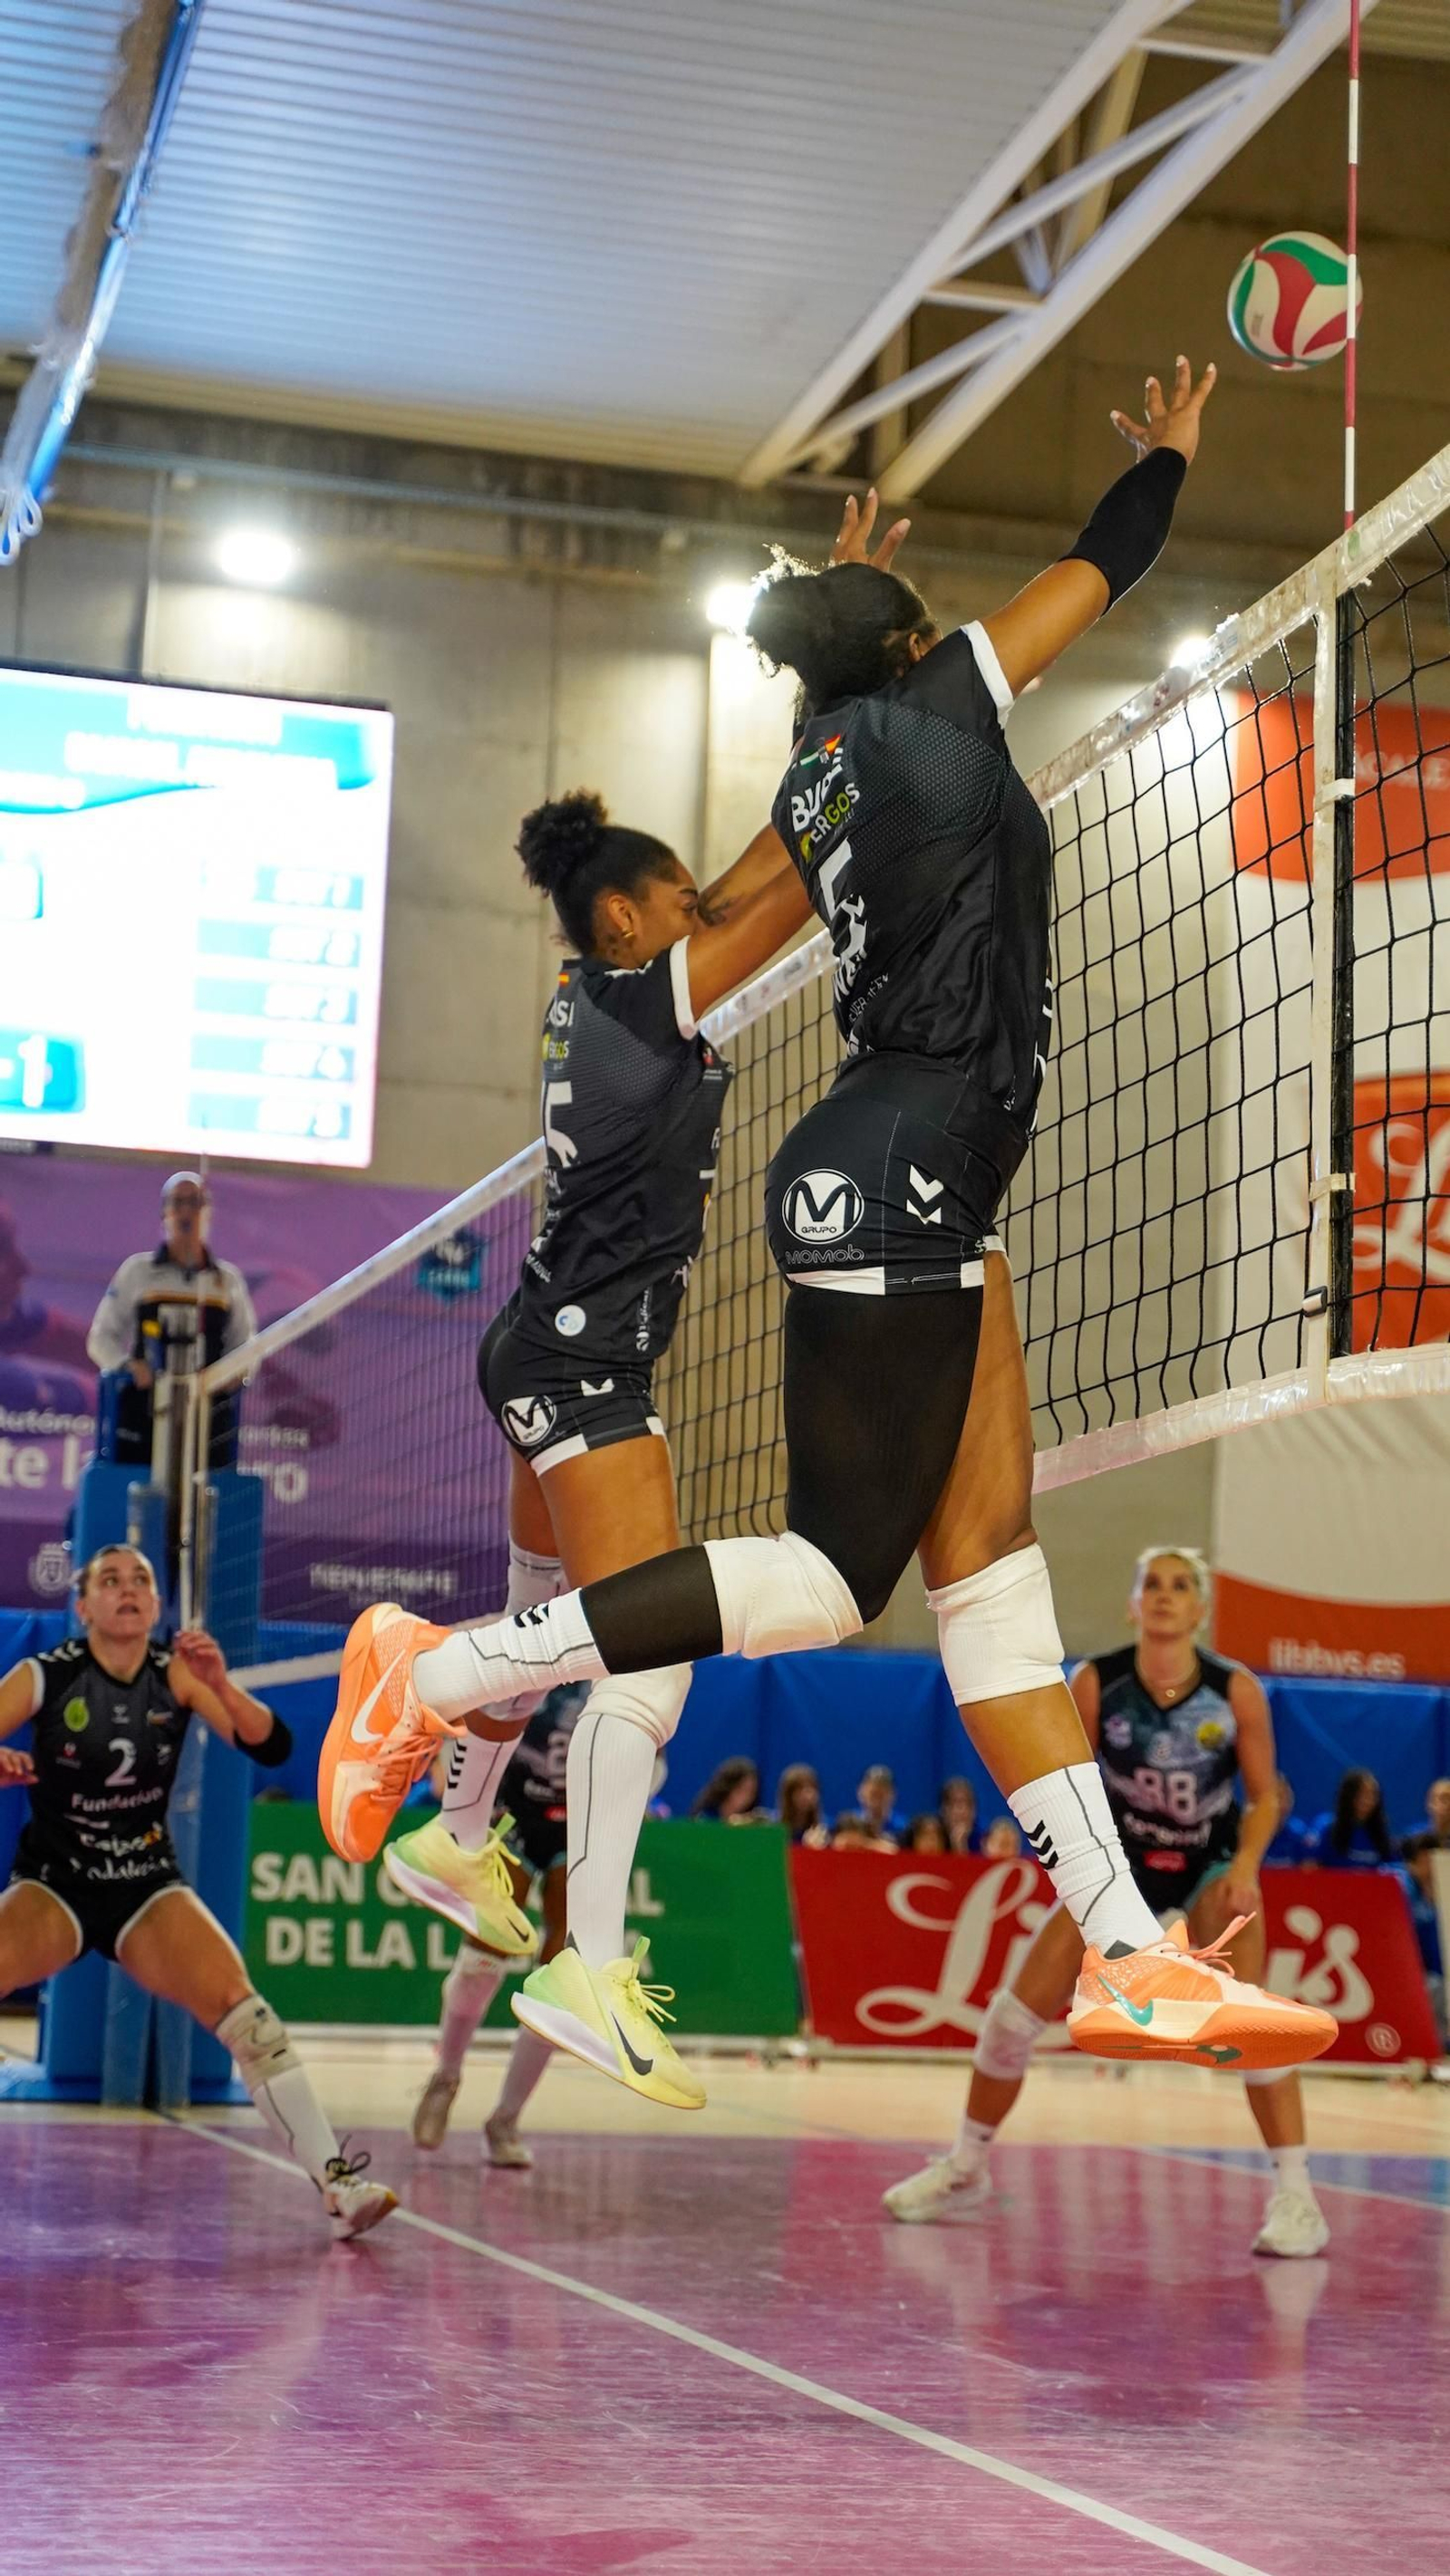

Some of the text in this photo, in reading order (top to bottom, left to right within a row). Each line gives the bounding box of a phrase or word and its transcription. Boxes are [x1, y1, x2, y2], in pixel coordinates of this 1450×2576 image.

[801, 1226, 837, 1234] GRUPO
[104, 1737, 136, 1787] 2
[252, 1852, 362, 1903] SAN
[266, 1916, 336, 1966] DE
[346, 1918, 417, 1970] LA
